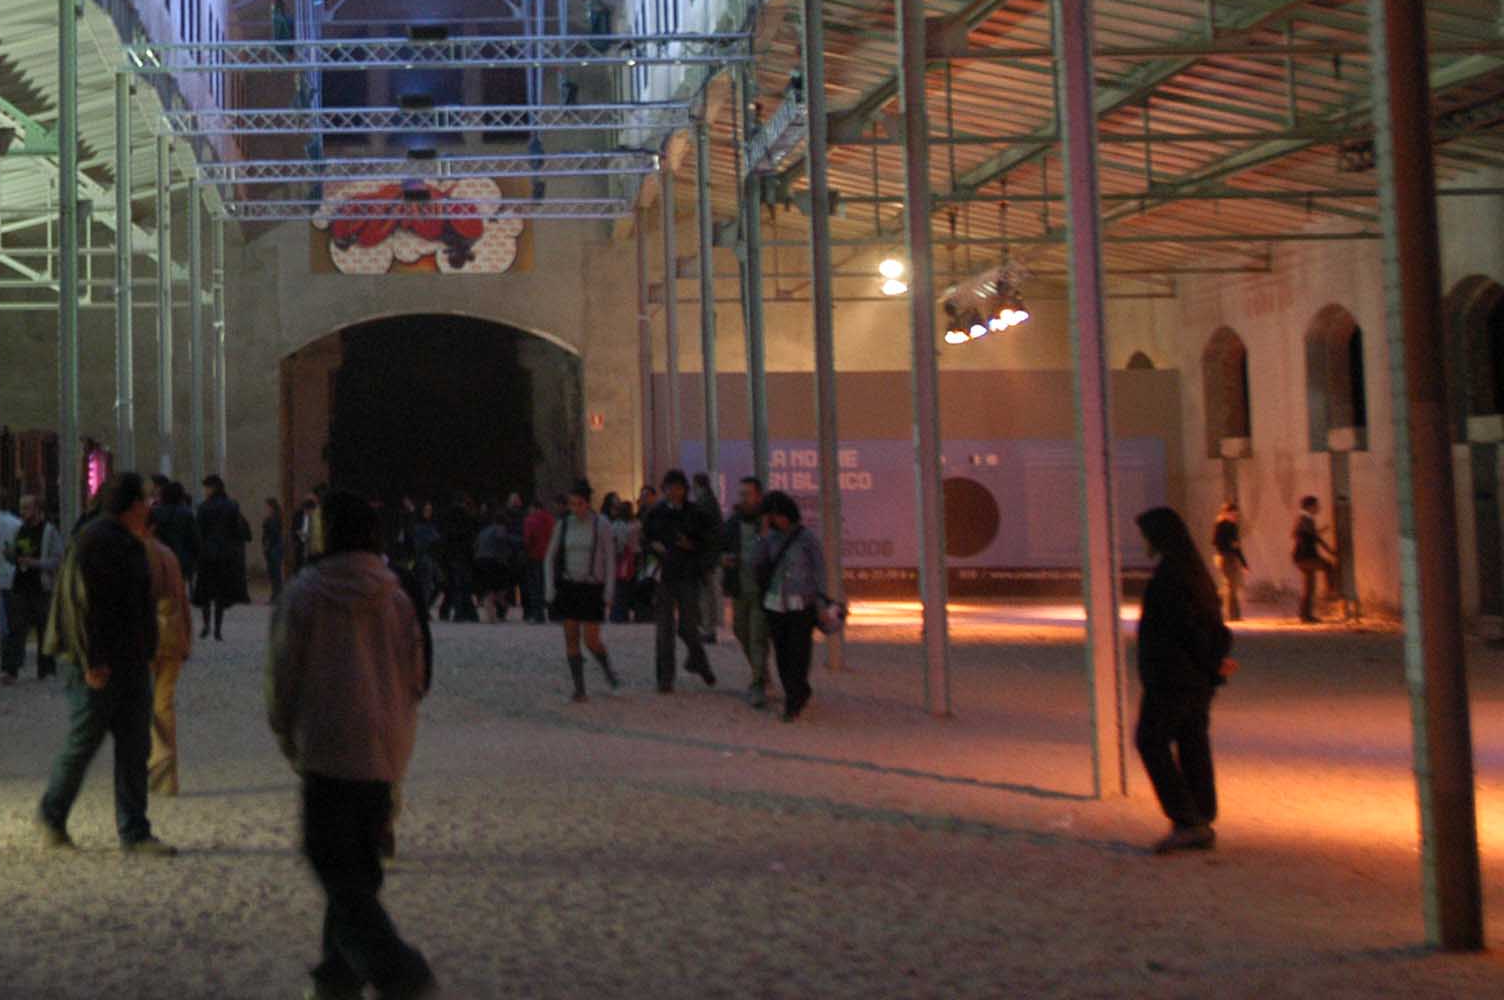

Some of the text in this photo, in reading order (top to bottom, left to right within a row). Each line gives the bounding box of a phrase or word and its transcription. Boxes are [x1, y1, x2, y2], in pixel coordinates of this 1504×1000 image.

[767, 449, 859, 469] A NOE
[792, 472, 873, 490] BLCO
